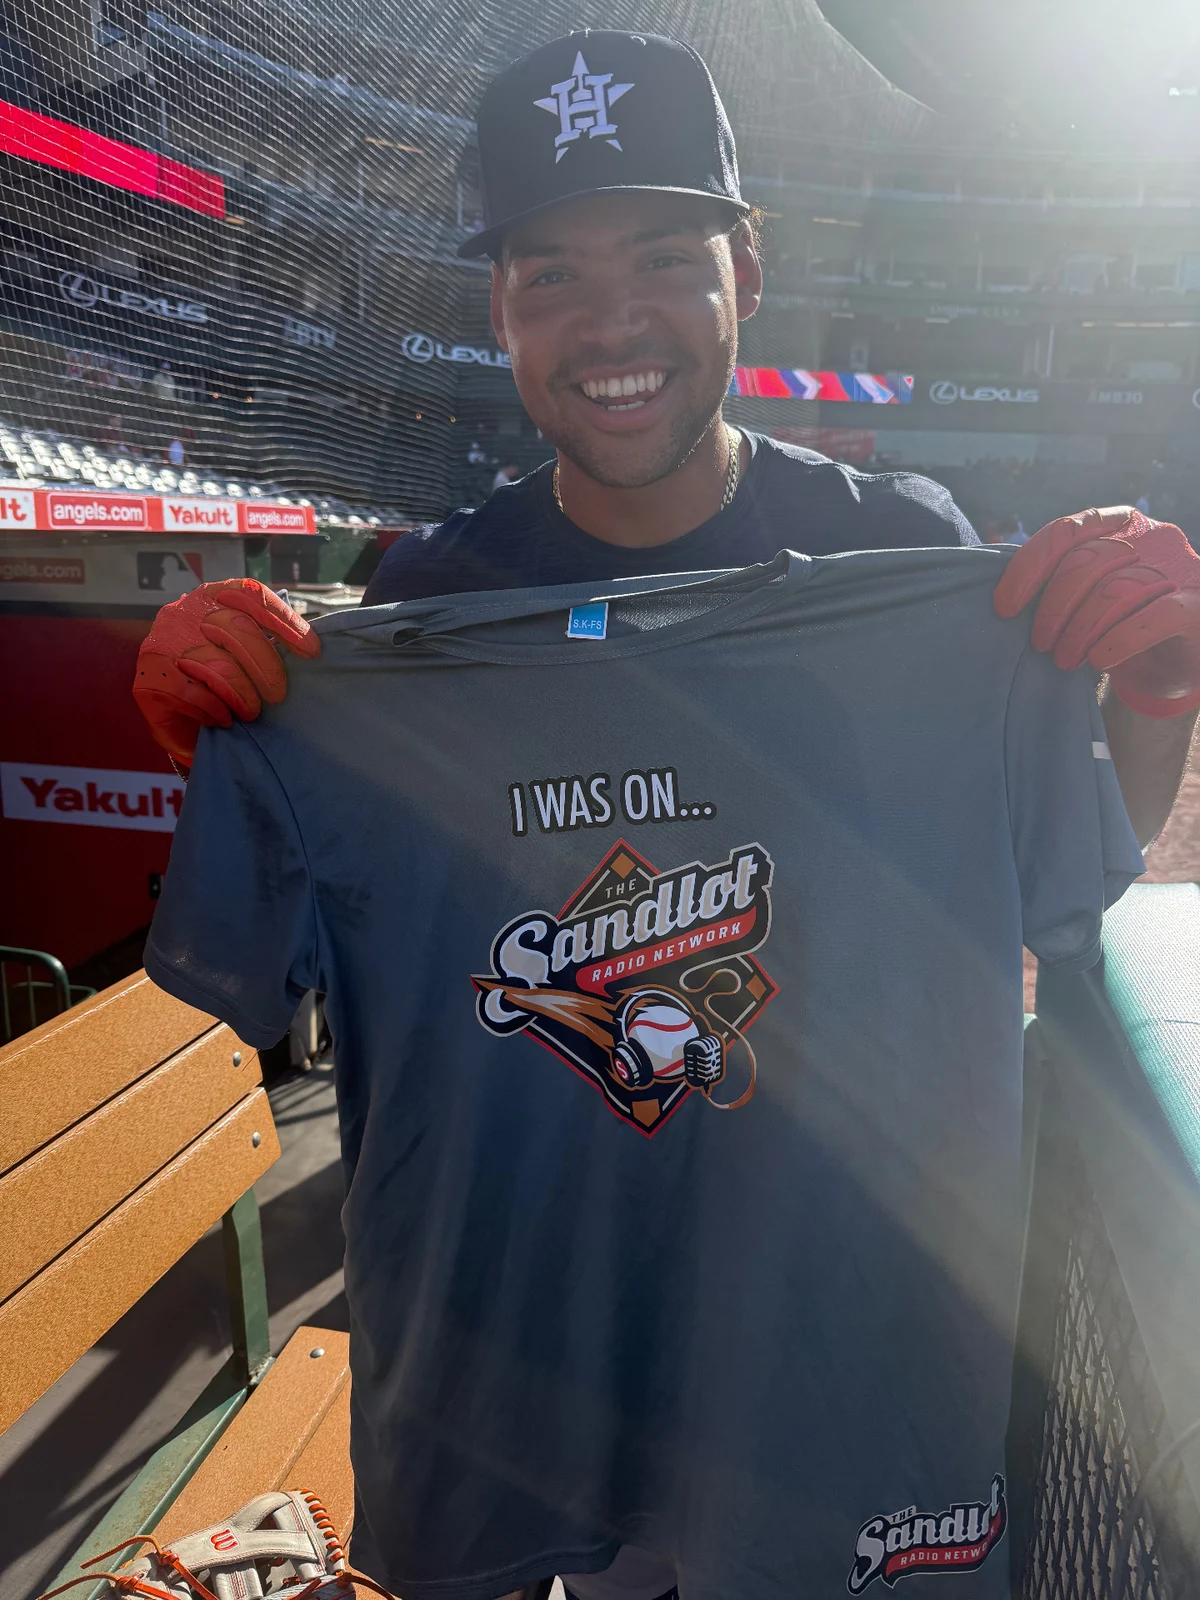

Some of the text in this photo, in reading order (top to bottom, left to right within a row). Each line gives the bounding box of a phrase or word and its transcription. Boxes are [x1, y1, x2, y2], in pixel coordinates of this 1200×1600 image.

[102, 284, 208, 323] LEXUS
[960, 385, 1039, 402] LEXUS
[54, 502, 143, 525] angels.com
[169, 505, 232, 526] Yakult
[248, 511, 304, 527] angels.com
[20, 776, 184, 819] Yakult
[512, 772, 713, 832] I WAS ON...
[605, 877, 637, 899] THE
[484, 853, 759, 1023] Sandlot
[591, 921, 742, 983] RADIO NETWORK
[892, 1507, 914, 1522] THE
[900, 1550, 938, 1566] RADIO
